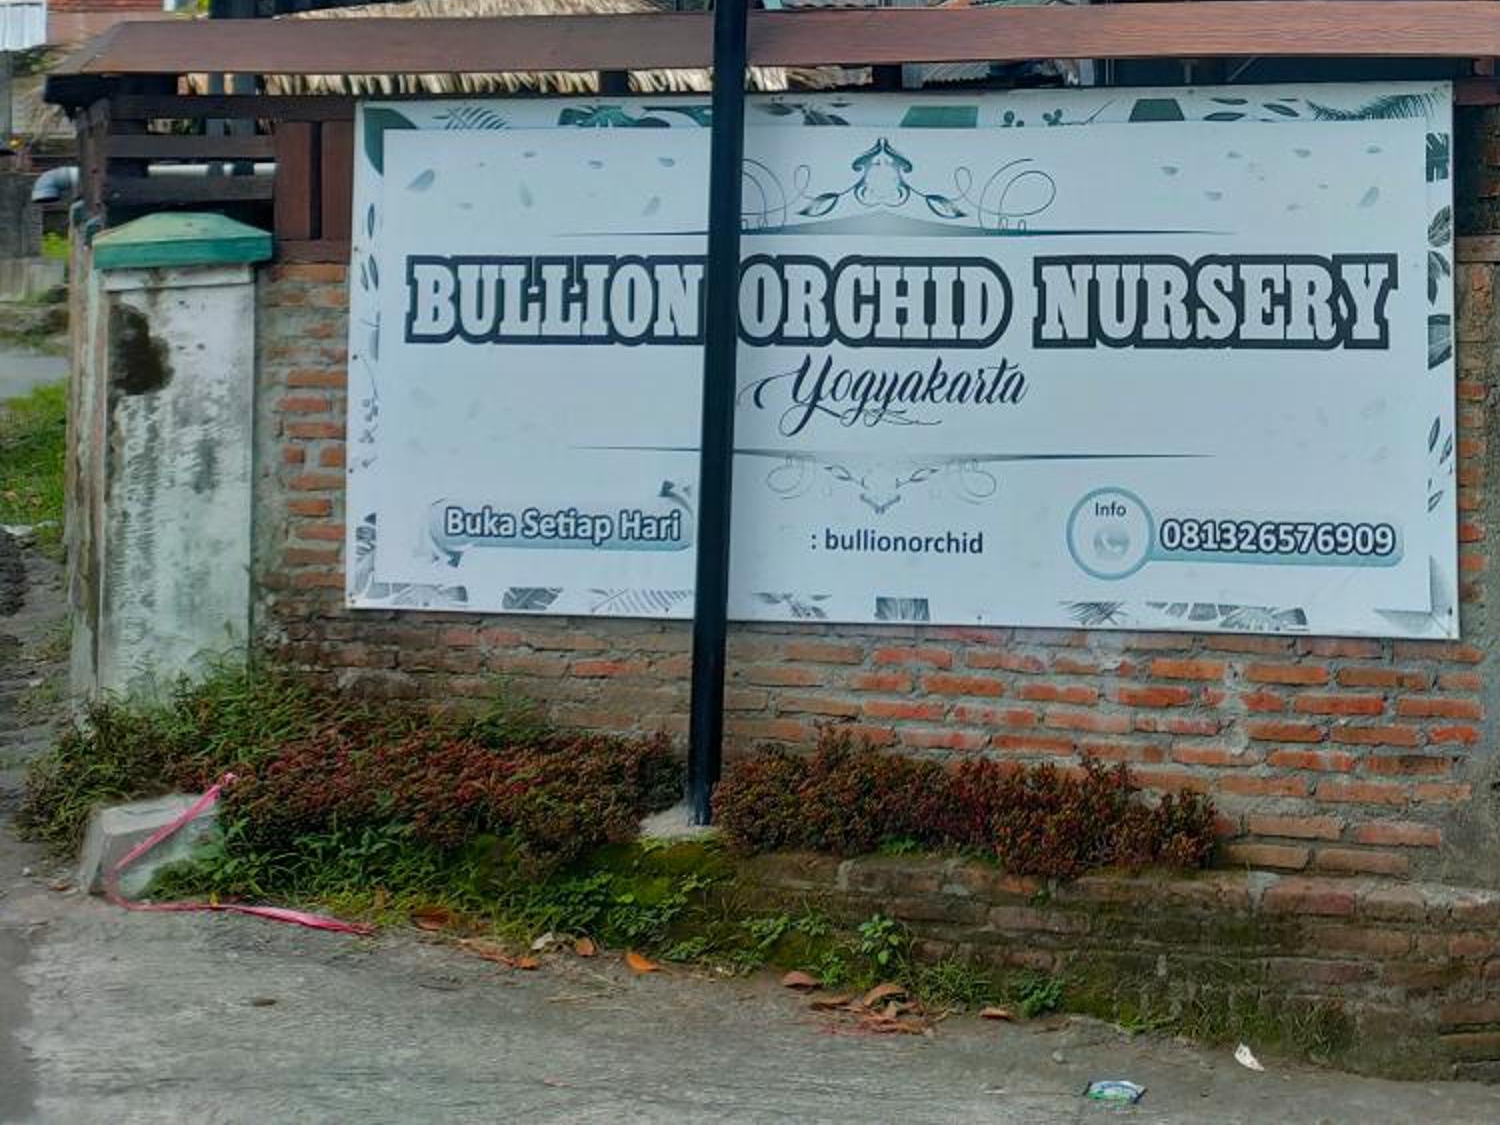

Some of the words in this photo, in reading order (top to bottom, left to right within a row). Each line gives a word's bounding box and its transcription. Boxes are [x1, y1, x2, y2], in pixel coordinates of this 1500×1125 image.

[406, 255, 707, 345] BULLION
[738, 255, 1013, 348] ORCHID
[1032, 254, 1398, 350] NURSERY
[753, 355, 1028, 437] Yogyakarta
[444, 506, 516, 539] Buka
[521, 508, 610, 547] Setiap
[618, 511, 682, 543] Hari
[1093, 500, 1127, 520] Info
[825, 527, 983, 555] bullionorchid
[1160, 518, 1396, 556] 081326576909
